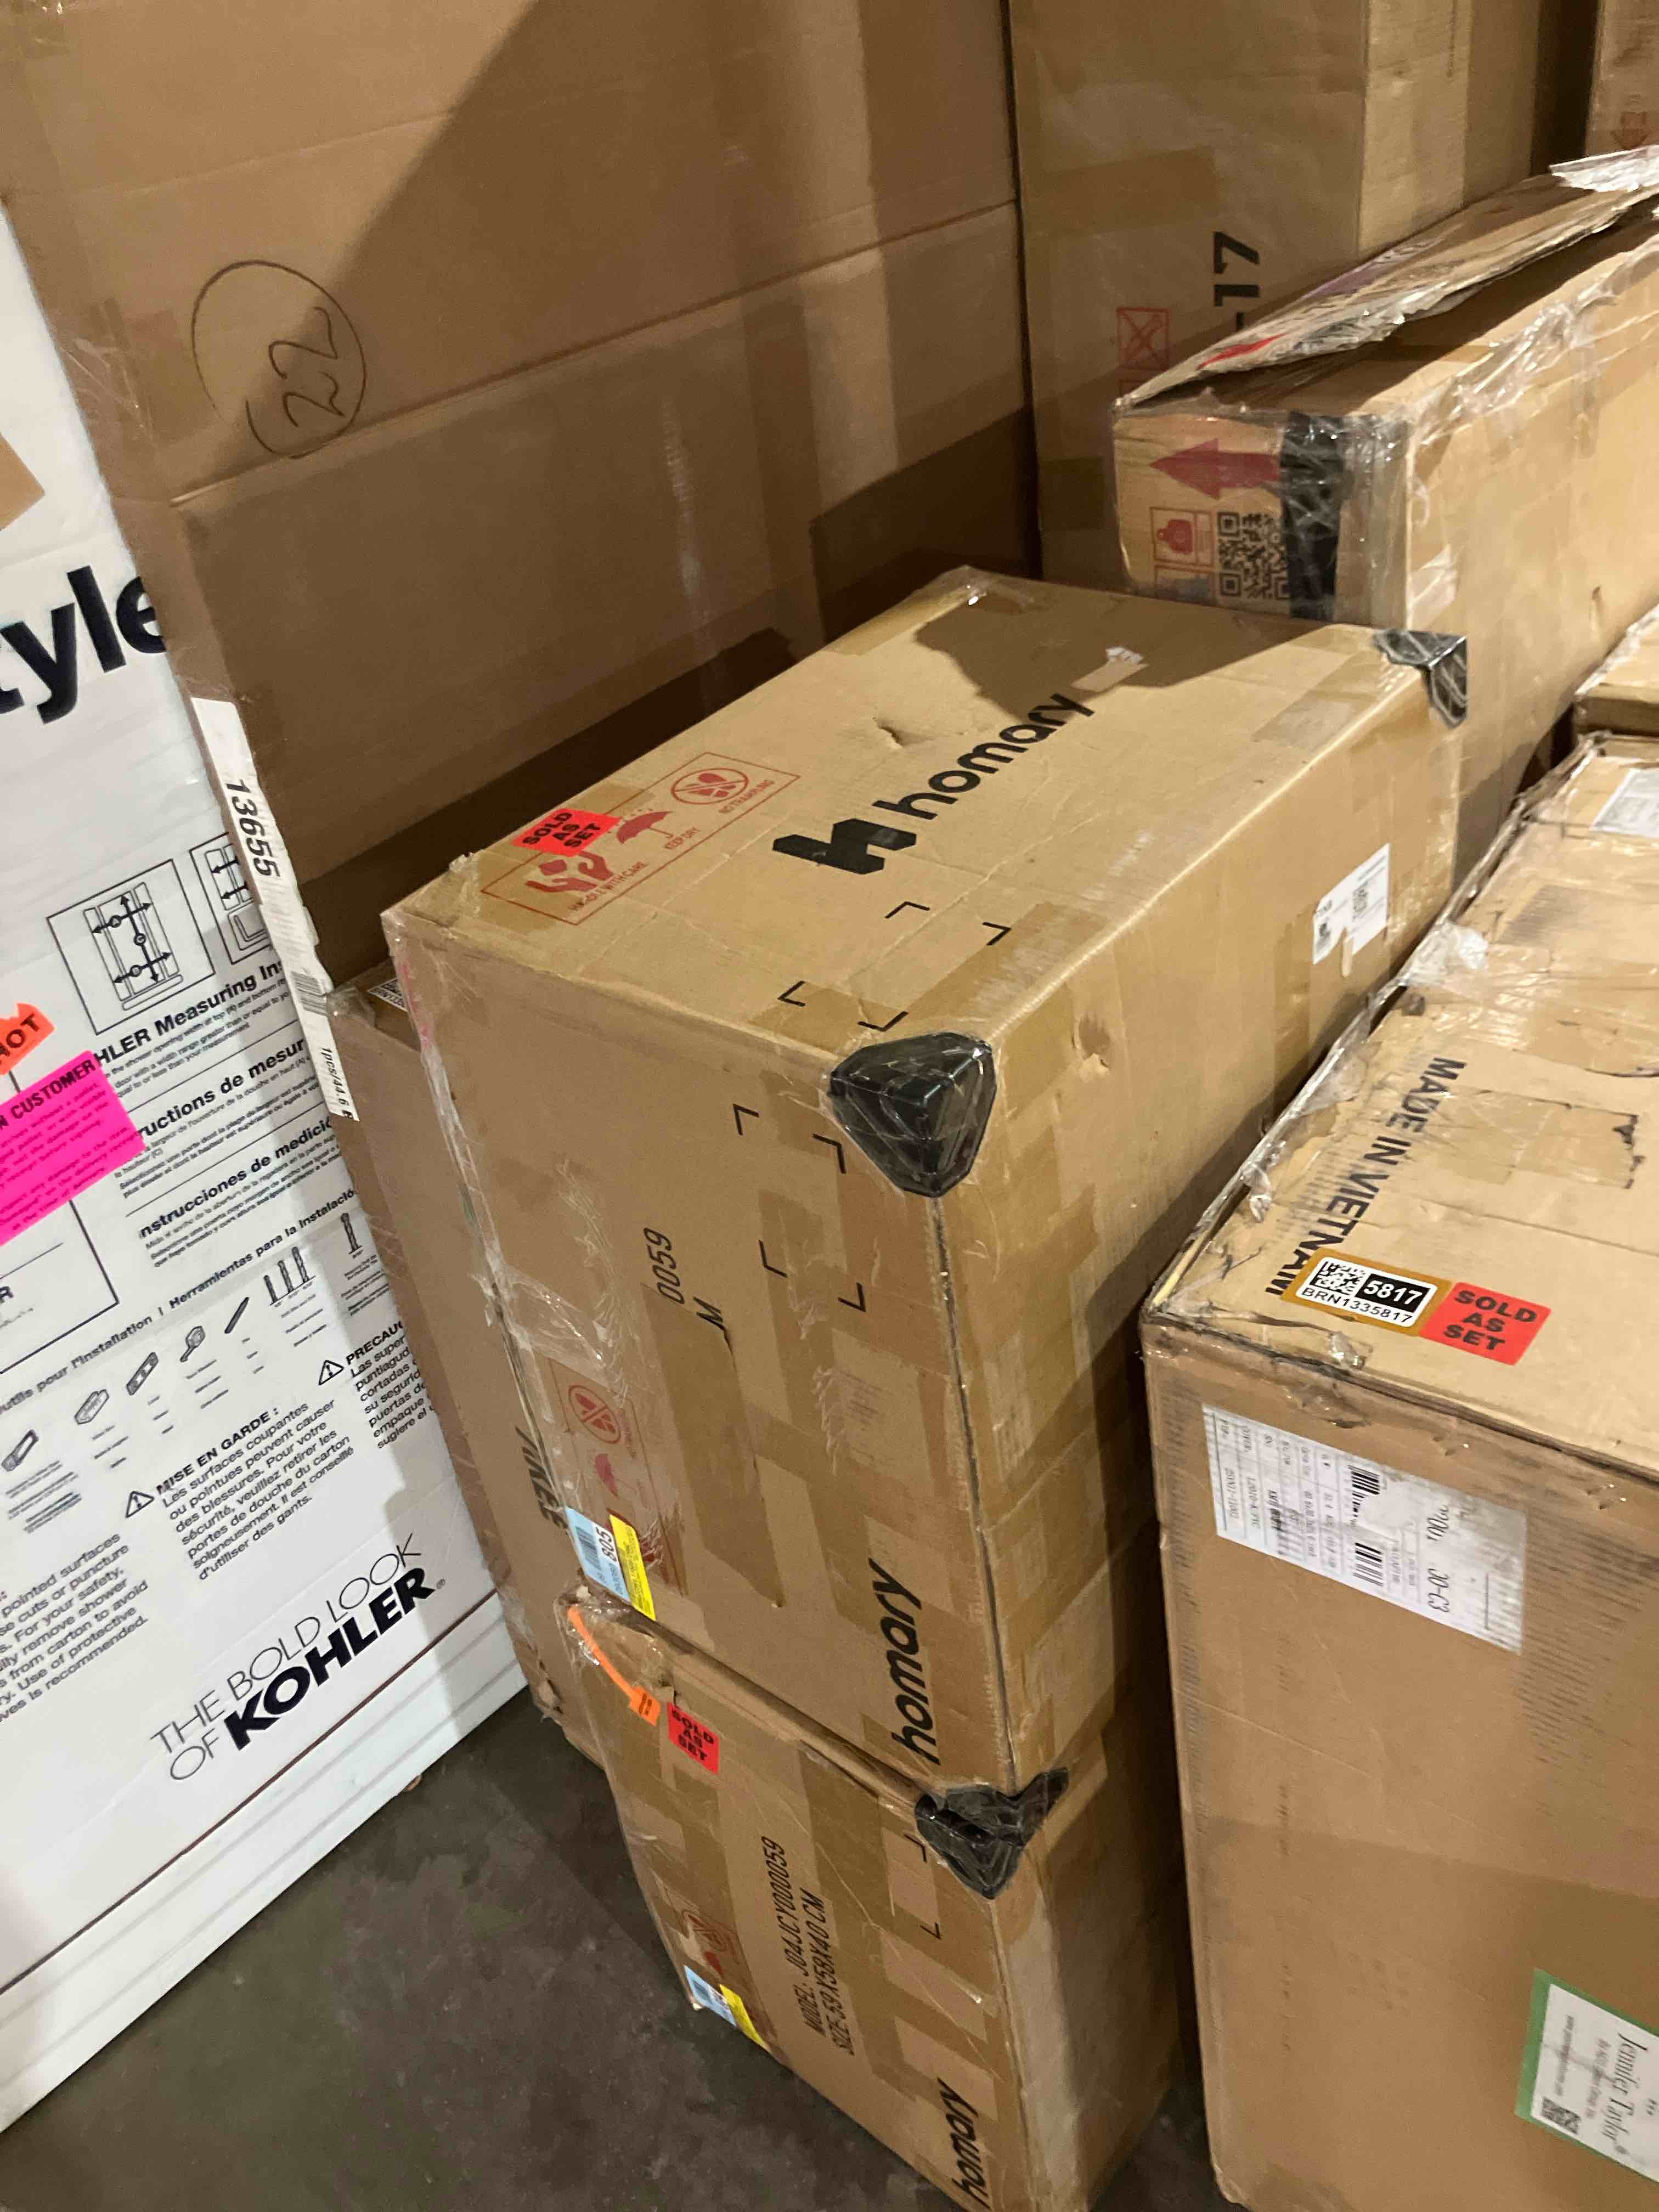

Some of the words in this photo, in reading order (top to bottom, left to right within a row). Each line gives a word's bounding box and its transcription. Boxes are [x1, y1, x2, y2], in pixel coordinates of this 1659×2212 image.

[872, 693, 1094, 820] homary
[224, 777, 279, 877] 13655
[522, 812, 574, 846] SOLD
[552, 823, 581, 841] AS
[563, 822, 602, 849] SET
[94, 1028, 151, 1066] HLER
[155, 975, 257, 1035] Measuring
[10, 1060, 95, 1119] CUSTOMER
[139, 1091, 215, 1136] ructions
[220, 1075, 244, 1094] de
[249, 1040, 303, 1078] mesur
[1384, 1057, 1469, 1134] MADE
[251, 1156, 271, 1172] de
[1363, 1135, 1412, 1166] IN
[0, 1387, 33, 1414] utils
[36, 1367, 67, 1392] pour
[169, 1254, 252, 1308] Herramientas
[256, 1235, 283, 1257] para
[285, 1226, 297, 1237] la
[299, 1188, 355, 1228] instalació
[642, 1228, 685, 1305] 0059
[1363, 1280, 1424, 1305] 5817
[1301, 1287, 1414, 1325] BRN1335817
[1442, 1325, 1506, 1351] SET
[1454, 1290, 1538, 1324] SOLD
[1463, 1313, 1508, 1333] AS
[351, 1359, 373, 1378] Las
[374, 1334, 409, 1362] super
[356, 1346, 413, 1391] puntiagud
[360, 1364, 410, 1402] cortadas
[364, 1400, 379, 1414] su
[380, 1368, 424, 1403] segurid
[369, 1392, 411, 1427] puertas
[374, 1398, 424, 1437] empaque
[156, 1464, 194, 1494] MISE
[196, 1448, 218, 1467] EN
[221, 1412, 270, 1450] GARDE
[162, 1488, 188, 1508] Les
[189, 1449, 244, 1489] surfaces
[246, 1403, 308, 1450] coupantes
[170, 1504, 187, 1520] ou
[189, 1465, 243, 1508] pointues
[245, 1429, 294, 1469] peuvent
[296, 1400, 334, 1431] causer
[377, 1418, 415, 1449] sugiere
[417, 1407, 427, 1419] el
[176, 1513, 200, 1532] des
[201, 1469, 264, 1514] blessures.
[266, 1443, 294, 1468] Pour
[296, 1422, 326, 1445] votre
[182, 1505, 235, 1545] sécurité,
[236, 1470, 281, 1505] veuillez
[283, 1443, 317, 1473] retirer
[318, 1430, 337, 1446] les
[187, 1525, 228, 1560] portes
[230, 1512, 246, 1526] de
[249, 1478, 292, 1513] douche
[295, 1464, 311, 1479] du
[313, 1436, 350, 1466] carton
[190, 1504, 283, 1568] soigneusement.
[290, 1481, 308, 1497] est
[309, 1447, 354, 1483] conseillé
[199, 1539, 249, 1580] d'utiliser
[252, 1522, 274, 1541] des
[276, 1496, 312, 1525] gants.
[595, 1526, 618, 1563] 805
[1, 1574, 57, 1618] pointed
[60, 1534, 120, 1578] surfaces
[13, 1621, 39, 1643] For
[41, 1597, 74, 1626] your
[78, 1567, 123, 1600] safety.
[18, 1599, 49, 1623] cuts
[51, 1585, 66, 1600] or
[69, 1545, 129, 1590] puncture
[9, 1654, 44, 1680] from
[47, 1621, 92, 1655] carton
[94, 1609, 110, 1622] to
[112, 1581, 148, 1611] avoid
[17, 1669, 48, 1690] Use
[50, 1653, 65, 1669] of
[69, 1607, 136, 1659] protective
[22, 1616, 75, 1655] remove
[78, 1578, 127, 1617] shower
[150, 1690, 225, 1753] THE
[227, 1616, 320, 1701] BOLD
[326, 1533, 421, 1622] LOOK
[27, 1689, 43, 1701] is
[45, 1616, 147, 1689] recommended.
[170, 1728, 218, 1780] OF
[223, 1568, 435, 1751] KOHLER
[868, 1557, 941, 1766] homary
[672, 1709, 715, 1746] SOLD
[678, 1734, 708, 1761] SET
[682, 1728, 703, 1749] AS
[799, 1887, 827, 1923] CM
[792, 1981, 827, 2038] MODEL:
[1611, 2032, 1648, 2095] Jennifer
[936, 2076, 992, 2210] homary
[1600, 2097, 1636, 2141] Taylor
